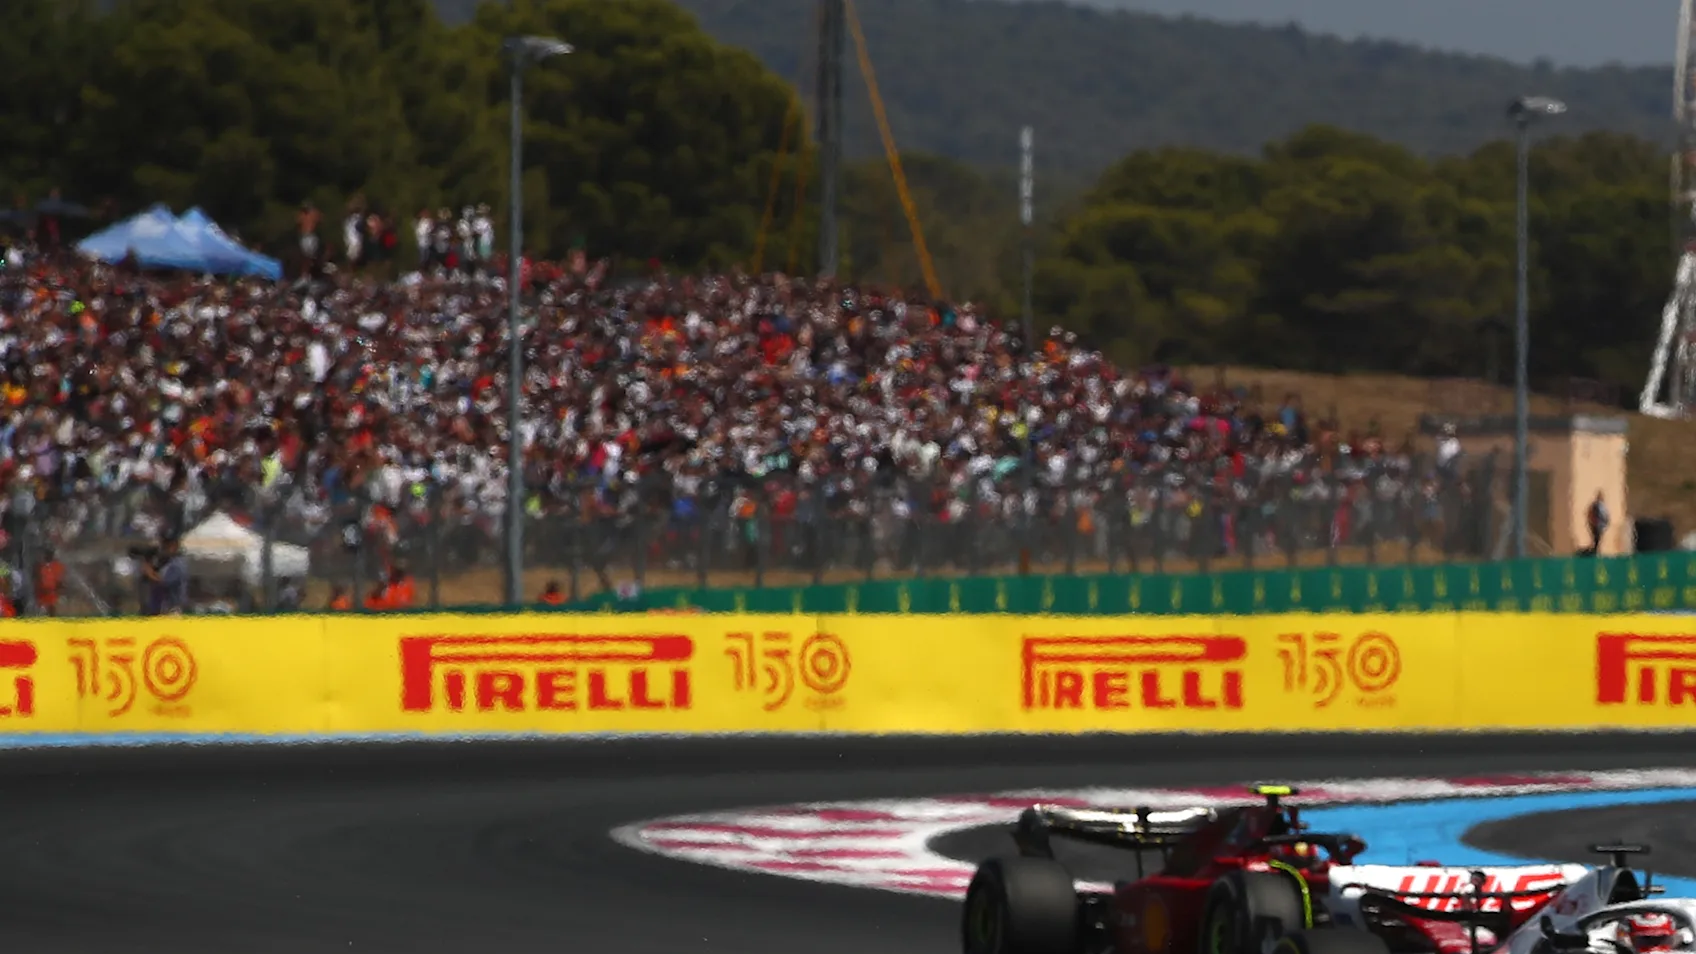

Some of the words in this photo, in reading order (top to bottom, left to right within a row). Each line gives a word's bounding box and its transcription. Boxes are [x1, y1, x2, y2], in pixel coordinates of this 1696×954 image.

[67, 636, 197, 717] 150
[399, 635, 694, 712] PIRELLI
[724, 631, 851, 711] 150
[1021, 633, 1247, 710] PIRELLI
[1277, 630, 1401, 708] 150
